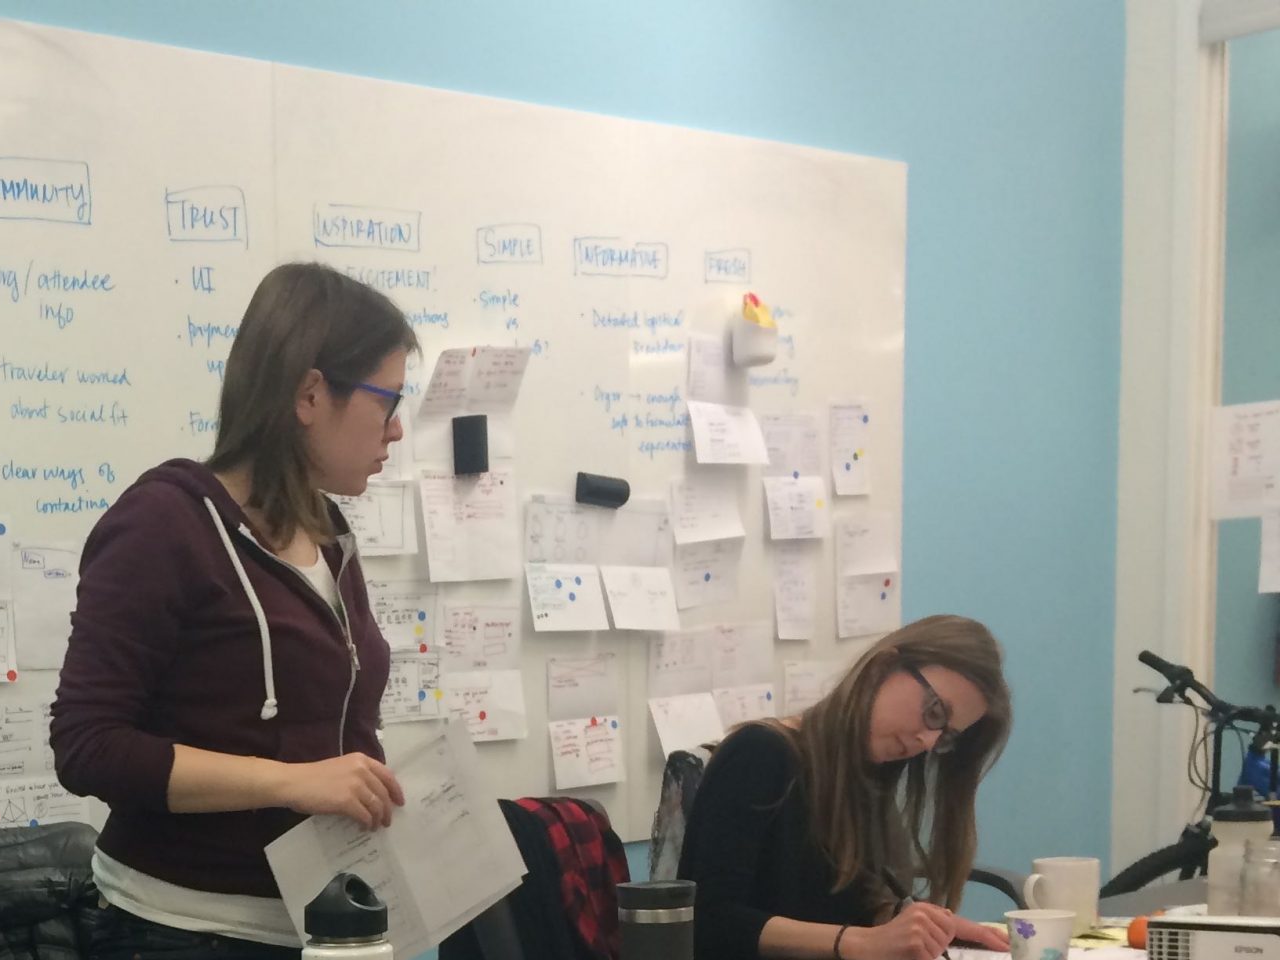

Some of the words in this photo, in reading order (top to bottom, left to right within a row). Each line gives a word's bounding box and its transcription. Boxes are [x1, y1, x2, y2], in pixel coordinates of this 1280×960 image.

[168, 200, 241, 234] TRUST
[316, 212, 412, 245] INSPIRATION
[192, 266, 216, 293] UI
[39, 303, 74, 329] info
[10, 398, 48, 420] about
[57, 404, 106, 424] social
[1, 464, 39, 482] clear
